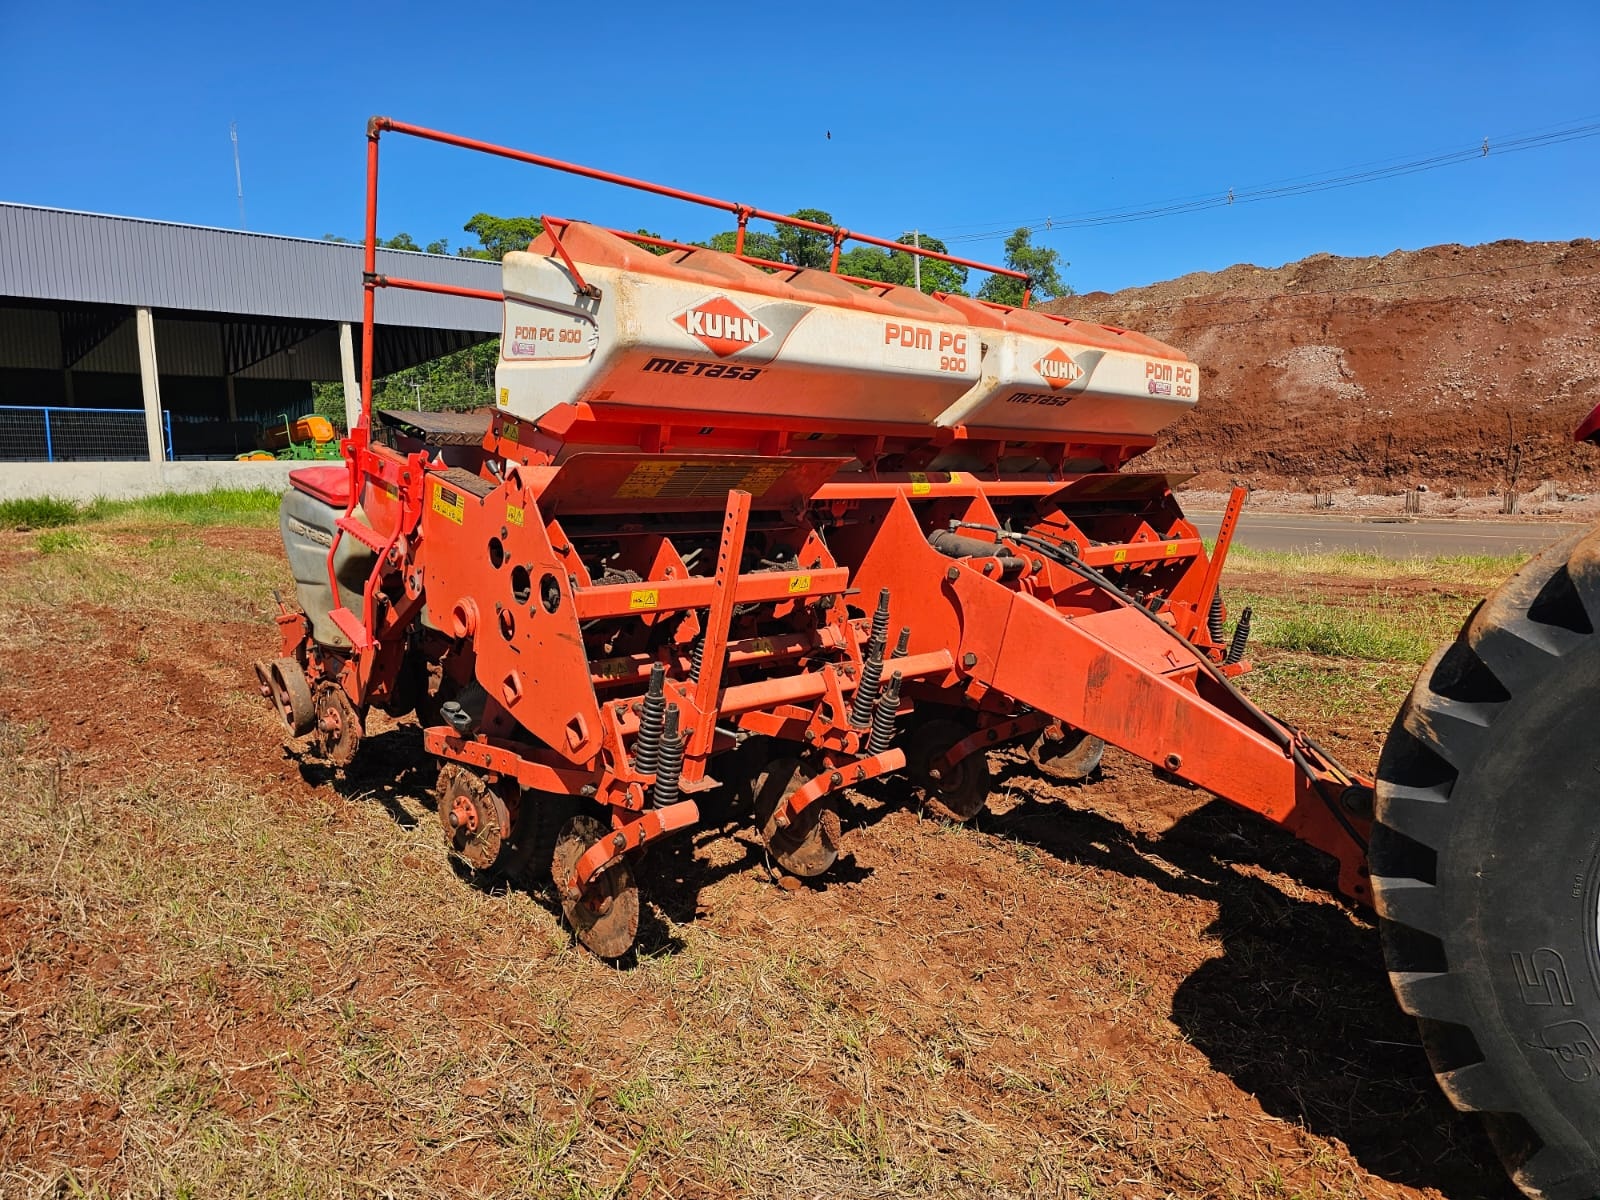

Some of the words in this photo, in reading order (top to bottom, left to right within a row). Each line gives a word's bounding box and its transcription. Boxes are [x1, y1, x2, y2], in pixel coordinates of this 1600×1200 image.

[515, 326, 537, 340] PDM
[540, 328, 555, 341] PG
[559, 328, 582, 343] 900
[685, 309, 760, 343] KUHN
[885, 322, 932, 350] PDM
[939, 331, 967, 354] PG
[940, 356, 967, 372] 900
[1040, 358, 1078, 380] KUHN
[1145, 361, 1172, 381] PDM
[1176, 366, 1192, 384] PG
[1176, 385, 1192, 397] 900
